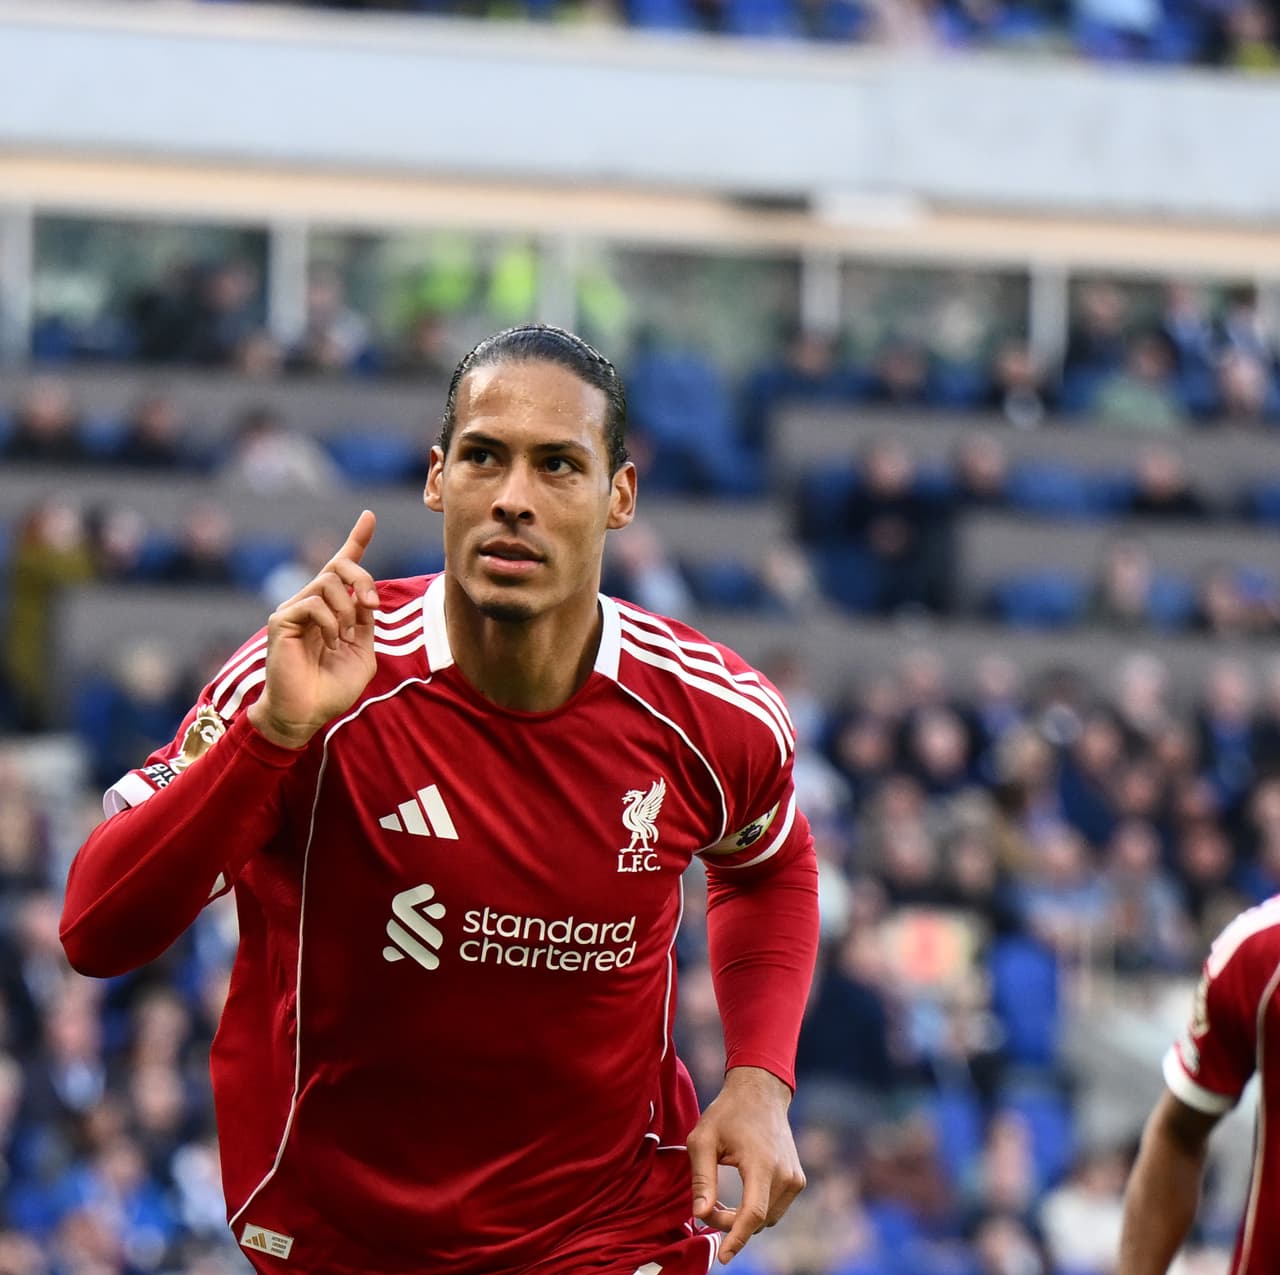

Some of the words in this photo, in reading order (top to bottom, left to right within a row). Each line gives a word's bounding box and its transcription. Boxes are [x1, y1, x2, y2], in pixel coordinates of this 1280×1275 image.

[617, 854, 662, 873] L.F.C.
[462, 906, 637, 945] standard
[459, 936, 637, 972] chartered
